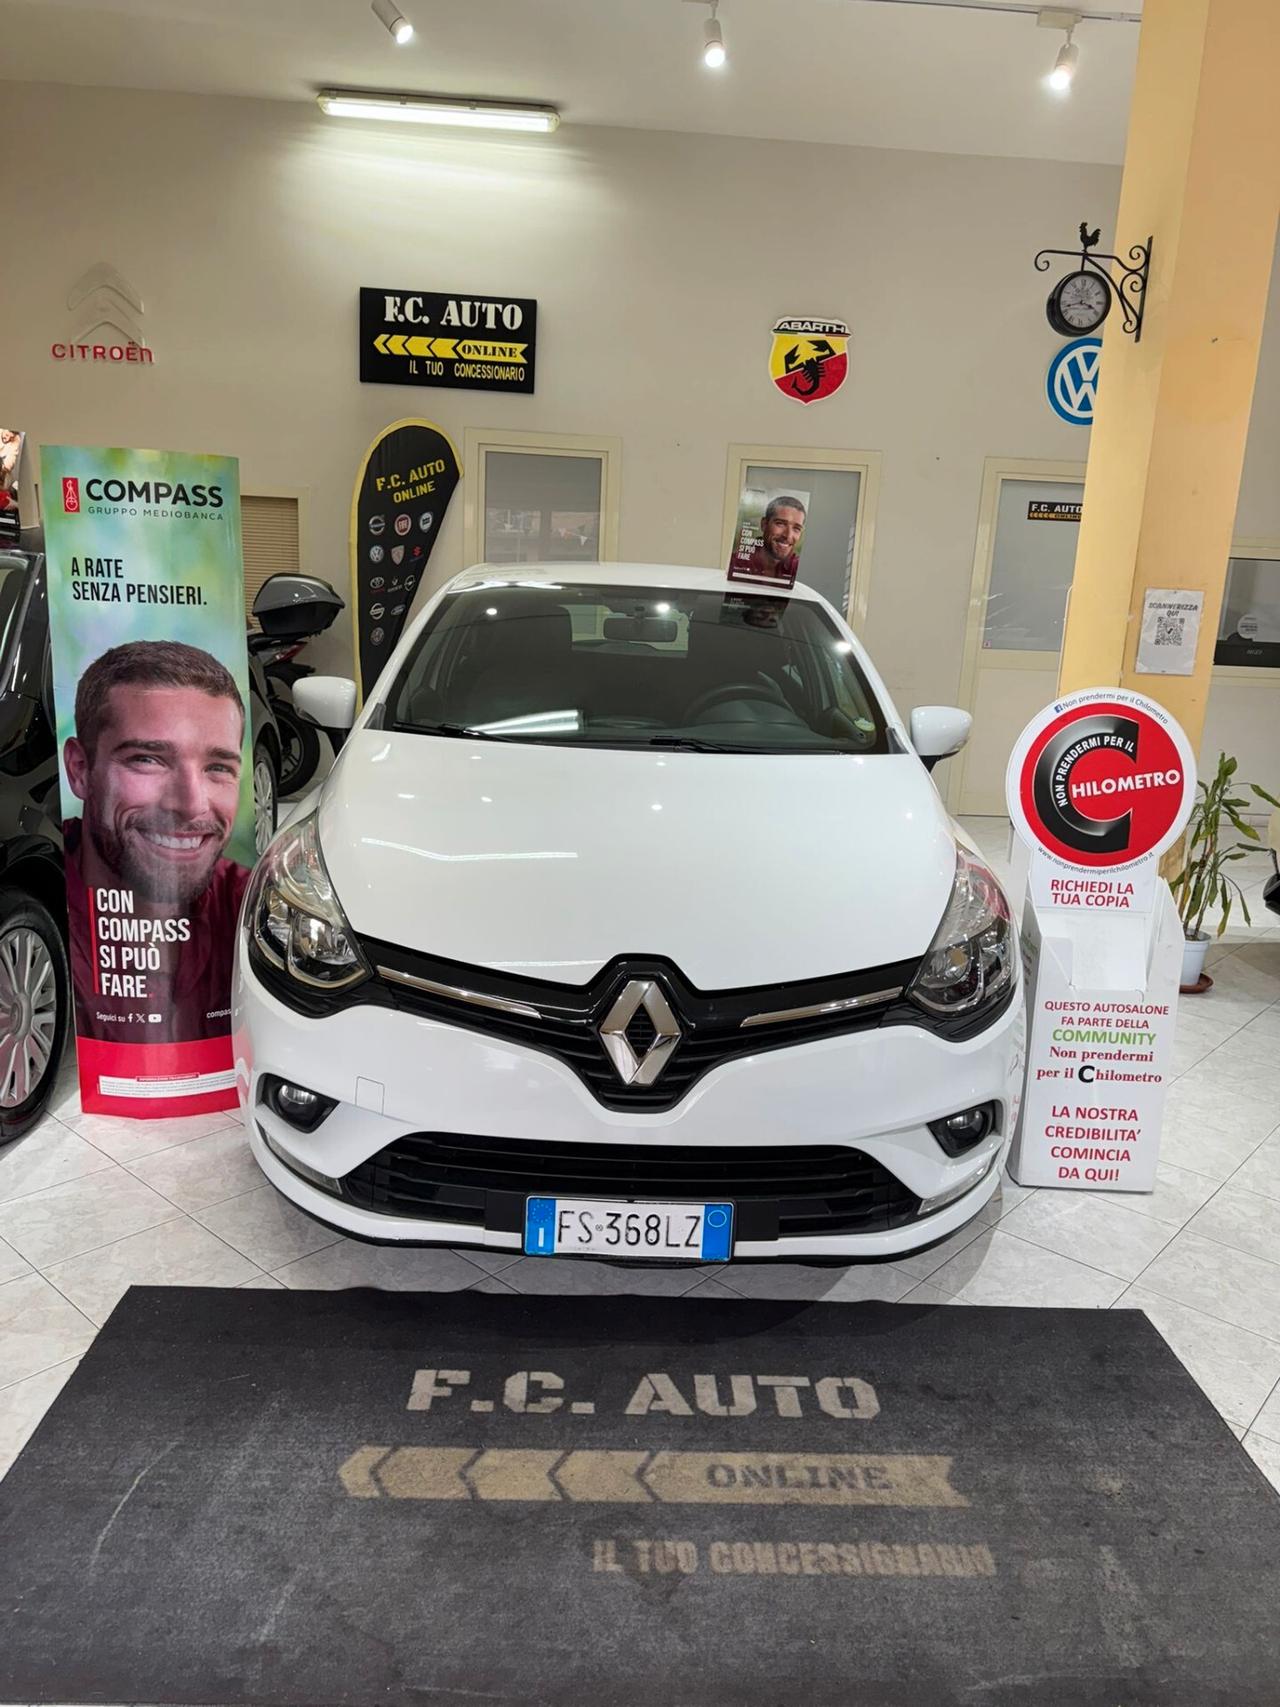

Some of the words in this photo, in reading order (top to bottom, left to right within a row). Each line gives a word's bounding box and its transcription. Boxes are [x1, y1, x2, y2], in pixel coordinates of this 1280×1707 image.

[384, 295, 431, 325] F.C.
[440, 300, 523, 331] AUTO
[779, 321, 846, 333] ABARTH
[461, 343, 518, 359] ONLINE
[409, 359, 419, 375] IL
[425, 360, 444, 376] TUO
[454, 362, 525, 382] CONCESSIONARIO
[376, 473, 406, 492] F.C.
[409, 459, 446, 483] AUTO
[85, 478, 224, 509] COMPASS
[393, 480, 436, 504] ONLINE
[88, 506, 138, 517] GRUPPO
[143, 509, 224, 521] MEDIOBANCA
[71, 556, 81, 577] A
[84, 558, 125, 579] RATE
[72, 580, 121, 603] SENZA
[126, 583, 208, 606] PENSIERI.
[1061, 698, 1078, 710] Non
[1078, 692, 1116, 706] prendermi
[1116, 693, 1130, 703] per
[1135, 698, 1169, 725] Chilometro
[1104, 735, 1123, 747] PER
[1124, 740, 1136, 753] IL
[1056, 736, 1101, 781] PRENDERMI
[1054, 784, 1069, 808] NON
[1038, 846, 1155, 875] www.nonprendermiperilchilometro.it
[1050, 879, 1113, 893] RICHIEDI
[1115, 881, 1134, 895] LA
[96, 887, 134, 914] CON
[1052, 893, 1081, 905] TUA
[1083, 894, 1130, 908] COPIA
[97, 917, 191, 943] COMPASS
[100, 945, 117, 969] SI
[122, 942, 161, 971] PUÒ
[118, 1013, 126, 1023] su
[1044, 1000, 1091, 1013] QUESTO
[1093, 1003, 1169, 1015] AUTOSALONE
[1061, 1016, 1075, 1026] FA
[1077, 1017, 1112, 1028] PARTE
[1115, 1018, 1149, 1029] DELLA
[1052, 1028, 1157, 1046] COMMUNITY
[1049, 1046, 1077, 1059] Non
[1081, 1049, 1153, 1062] prendermi
[1036, 1068, 1060, 1081] per
[1064, 1067, 1074, 1079] il
[1078, 1065, 1162, 1084] Chilometro
[1052, 1105, 1071, 1119] LA
[1075, 1106, 1139, 1121] NOSTRA
[1045, 1125, 1142, 1142] CREDIBILITA'
[1051, 1146, 1131, 1162] COMINCIA
[1058, 1167, 1080, 1180] DA
[1084, 1167, 1120, 1182] QUI!
[407, 1369, 595, 1413] F.C.
[624, 1372, 882, 1419] AUTO
[706, 1462, 893, 1491] ONLINE
[632, 1539, 698, 1574] TUO
